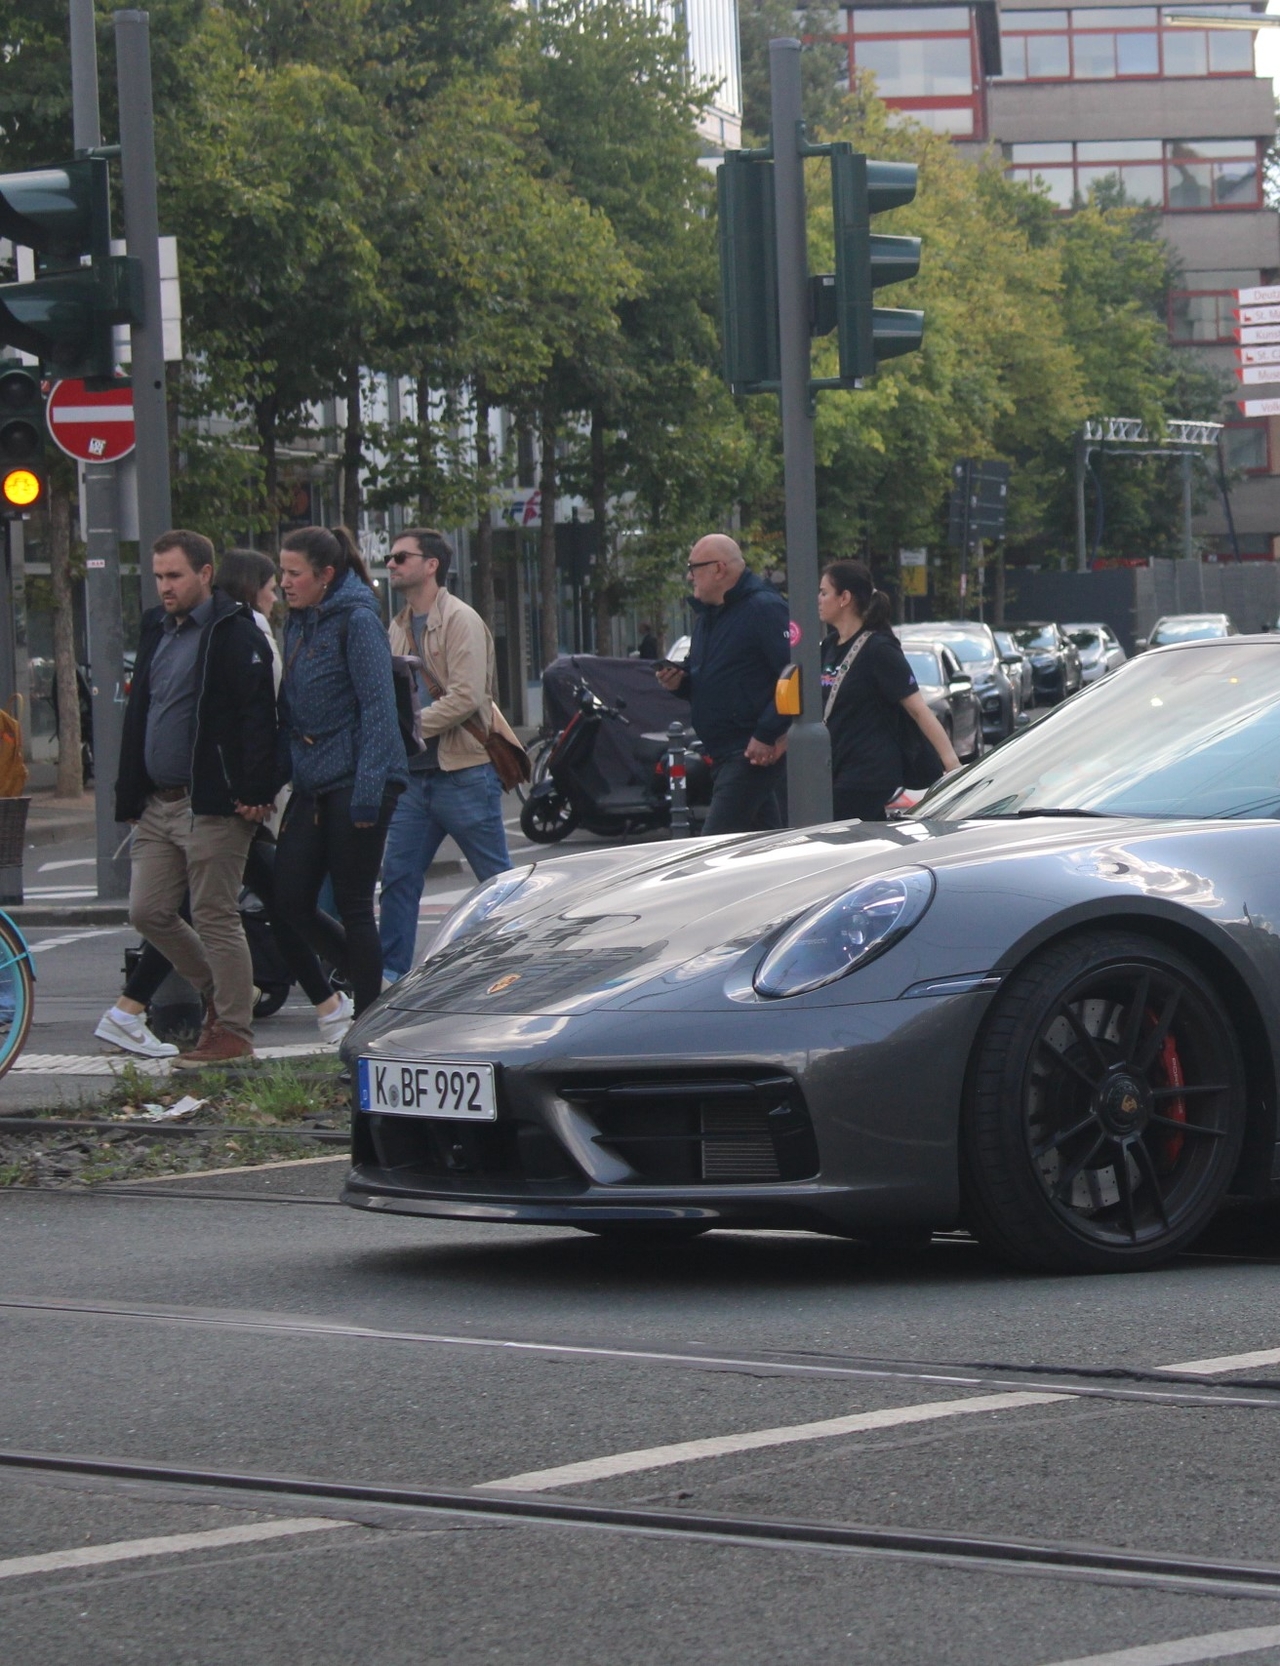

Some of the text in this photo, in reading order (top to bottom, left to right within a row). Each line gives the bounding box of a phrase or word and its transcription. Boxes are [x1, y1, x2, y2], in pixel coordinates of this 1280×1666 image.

[1257, 351, 1270, 361] St.
[375, 1065, 483, 1112] K BF 992
